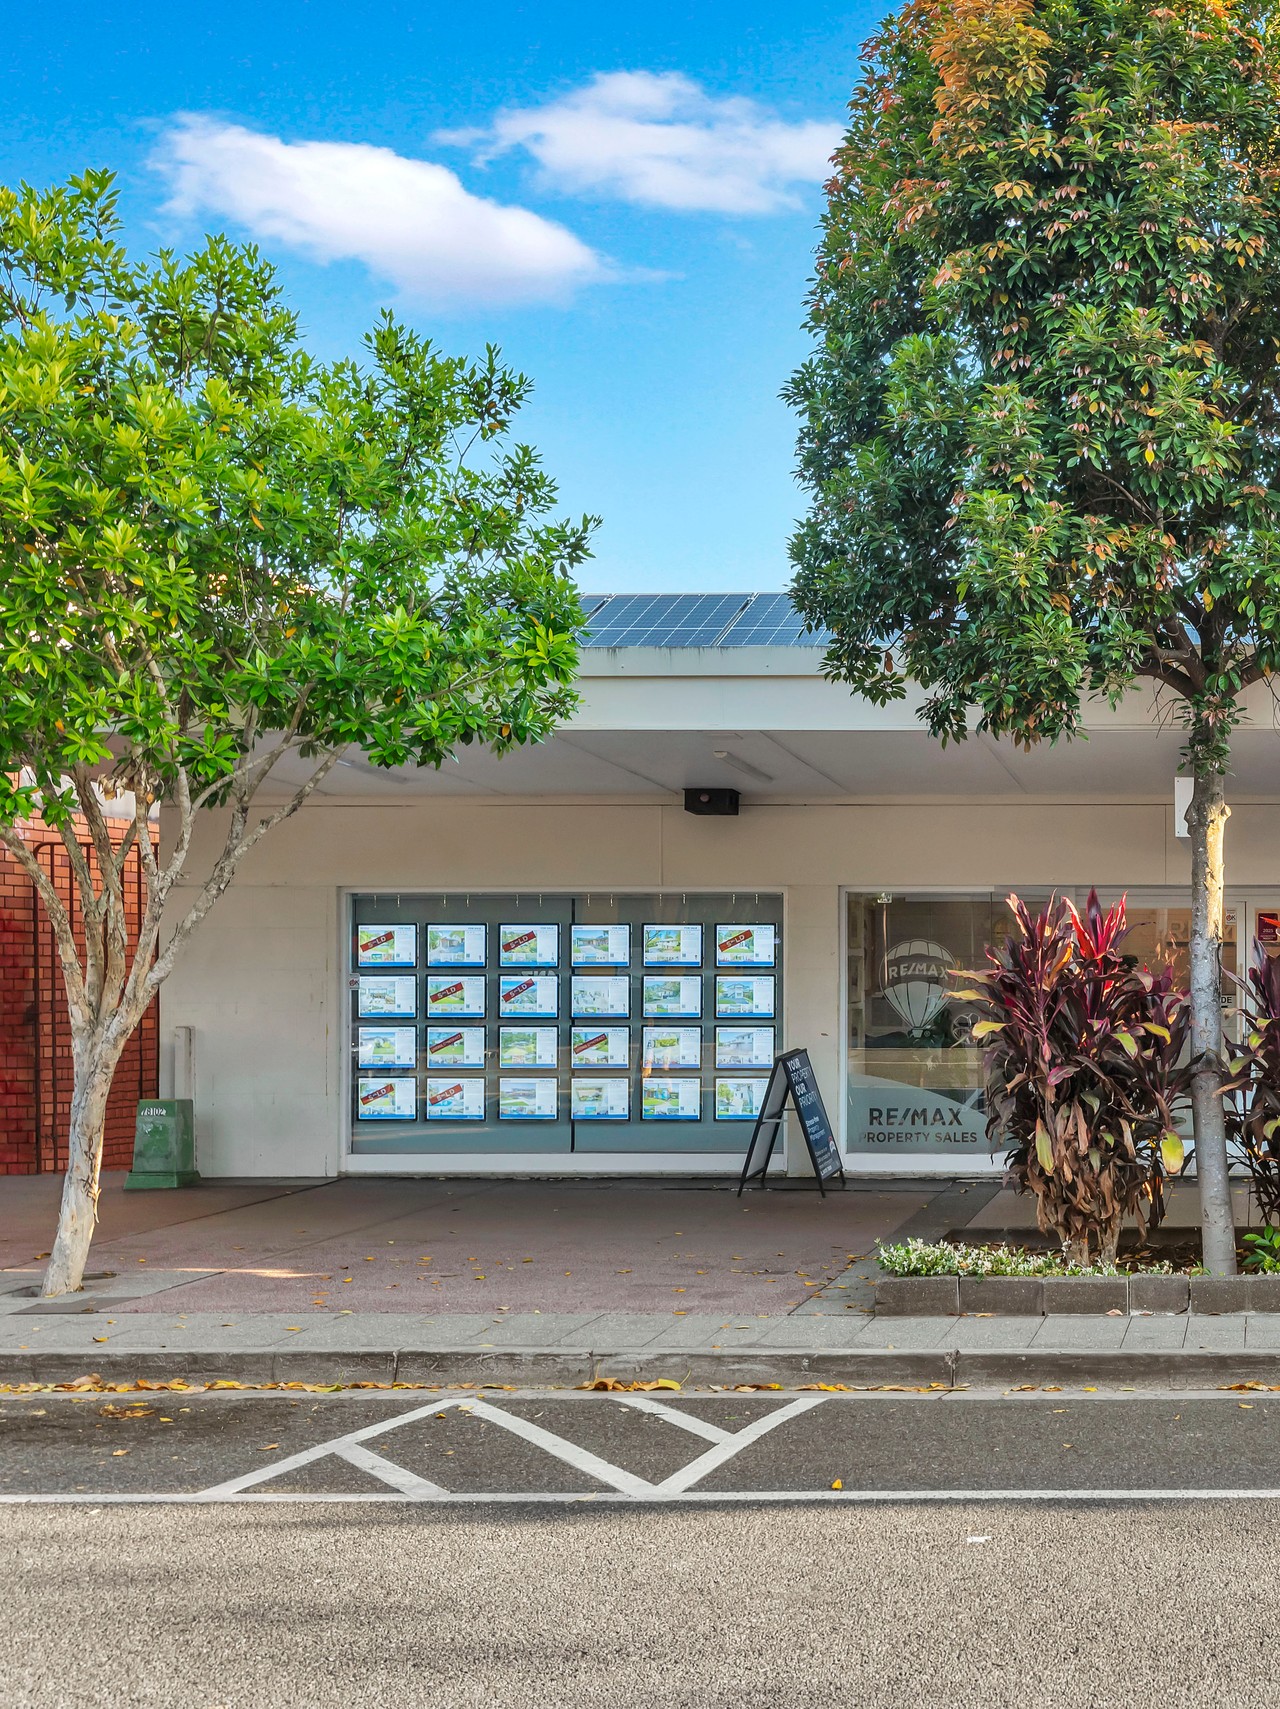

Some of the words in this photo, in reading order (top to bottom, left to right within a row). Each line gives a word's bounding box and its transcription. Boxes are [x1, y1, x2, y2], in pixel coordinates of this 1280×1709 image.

[888, 962, 949, 980] RE/MAX
[787, 1058, 801, 1071] YOUR
[795, 1083, 807, 1096] OUR
[869, 1107, 963, 1126] RE/MAX
[935, 1131, 978, 1143] SALES
